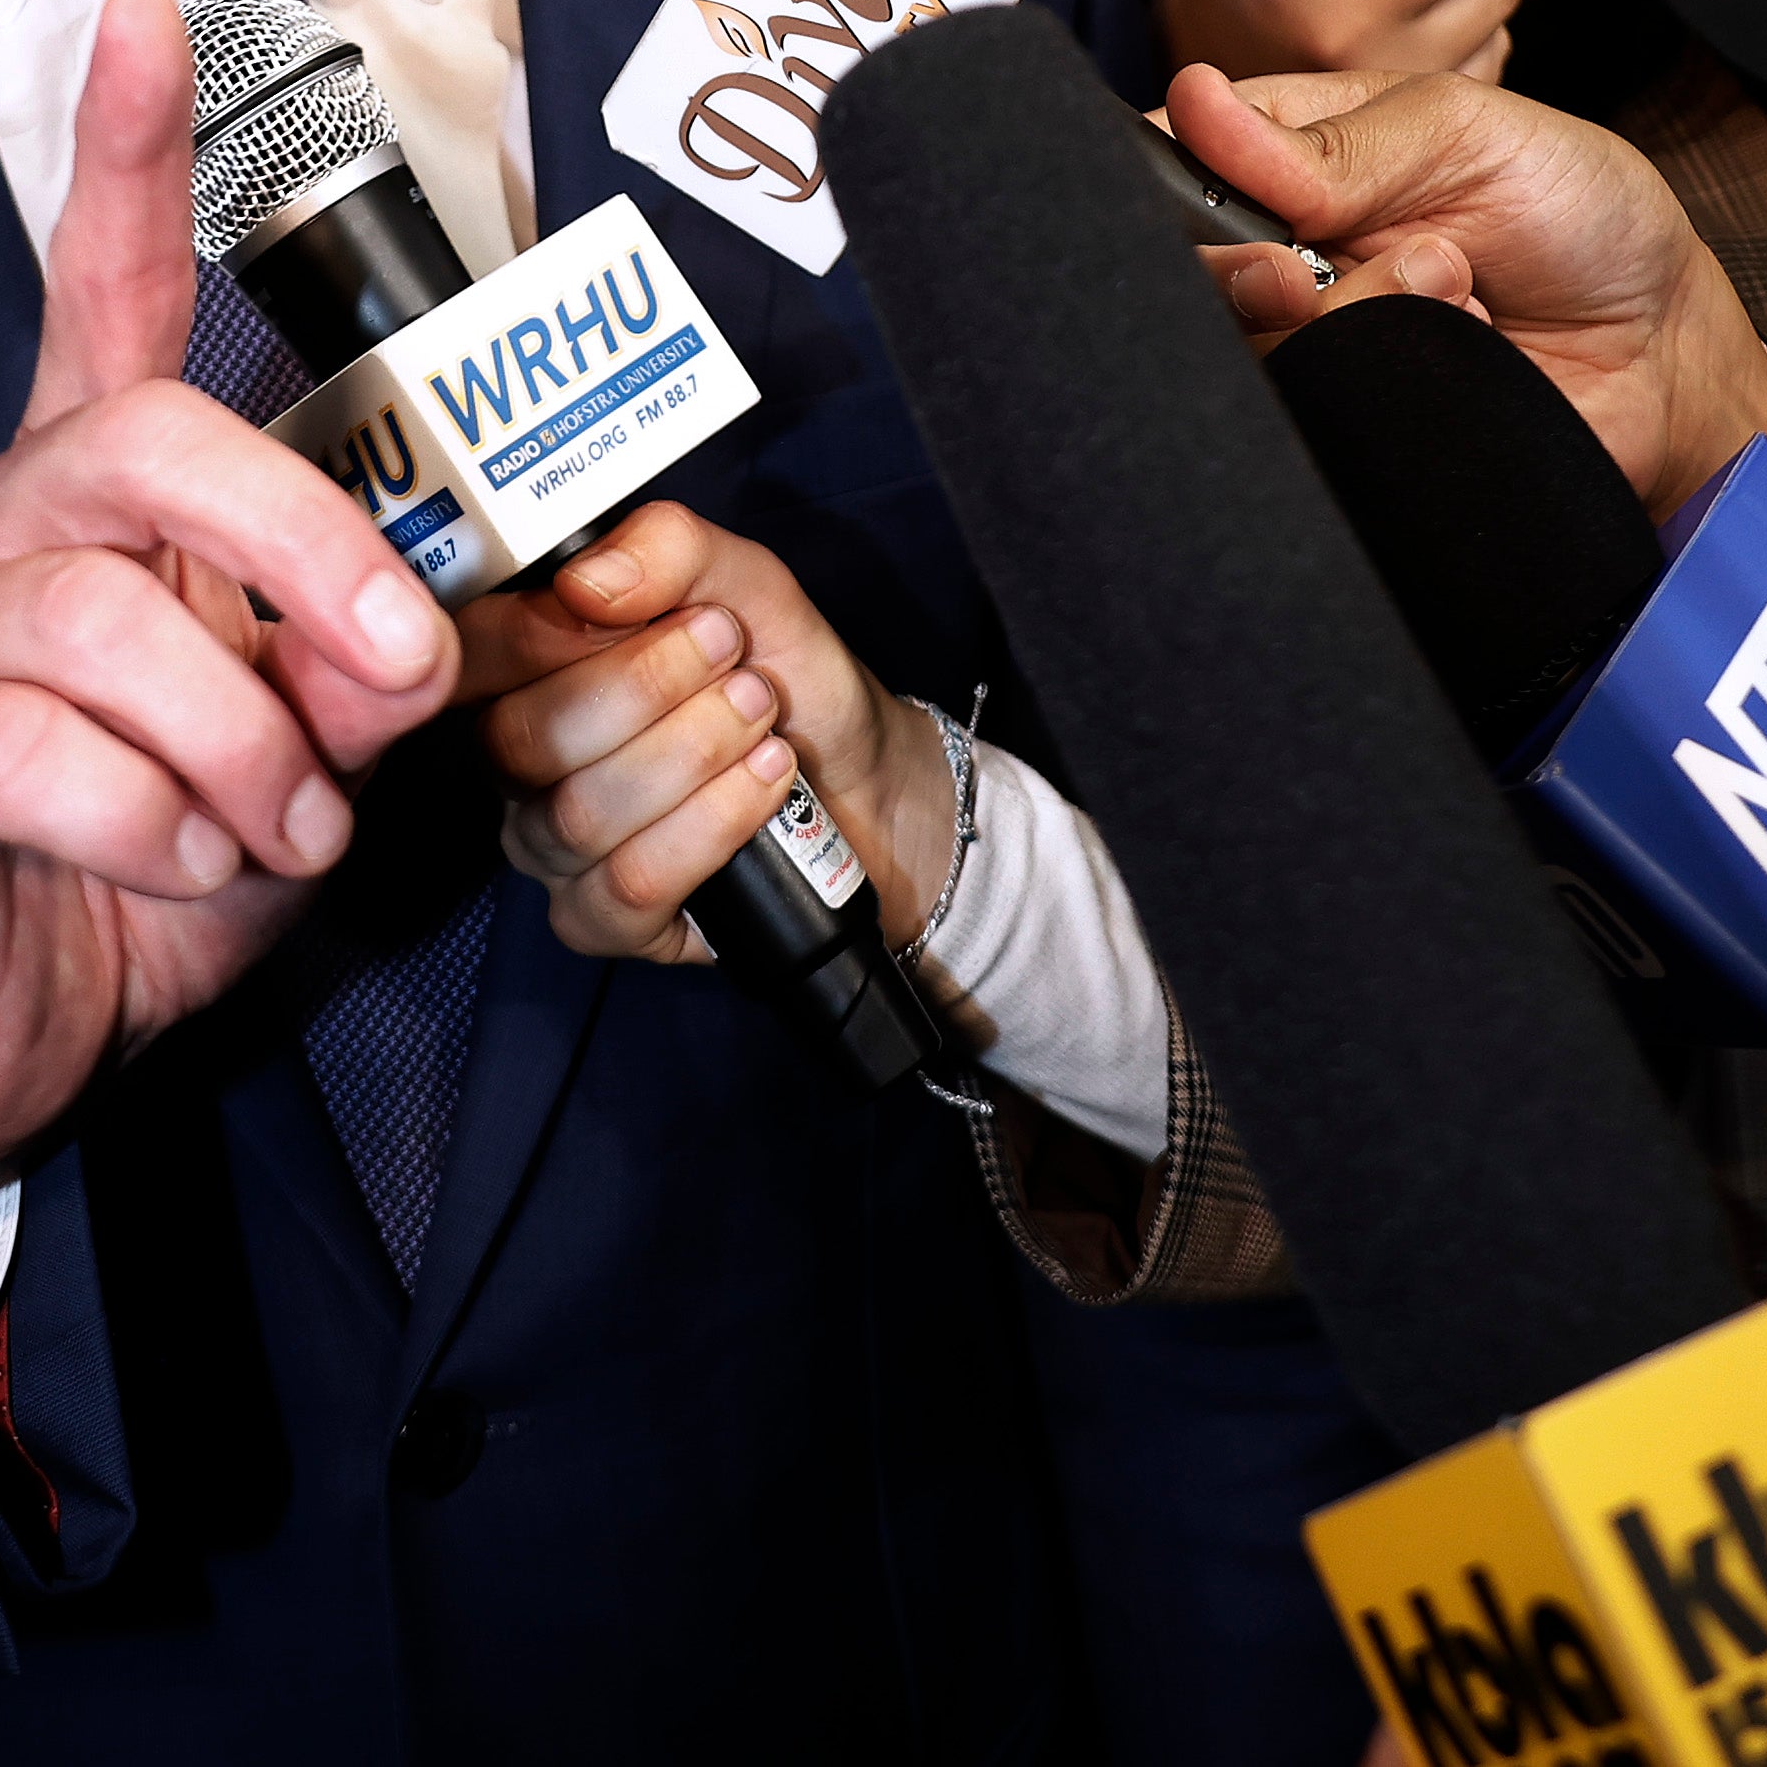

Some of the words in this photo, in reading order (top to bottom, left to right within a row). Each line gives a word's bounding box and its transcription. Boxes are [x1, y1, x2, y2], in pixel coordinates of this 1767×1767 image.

[423, 244, 662, 454] WRHU
[489, 440, 542, 482] RADIO
[553, 386, 621, 438] HOFSTRA
[617, 332, 699, 394] UNIVERSITY
[321, 402, 420, 520] HU
[529, 424, 628, 501] WRHU.ORG
[635, 399, 665, 429] FM
[665, 374, 699, 409] 88.7
[389, 498, 455, 544] NIVERSITY
[425, 537, 458, 573] 88.7
[788, 794, 810, 821] abc
[1359, 1560, 1627, 1767] kbla
